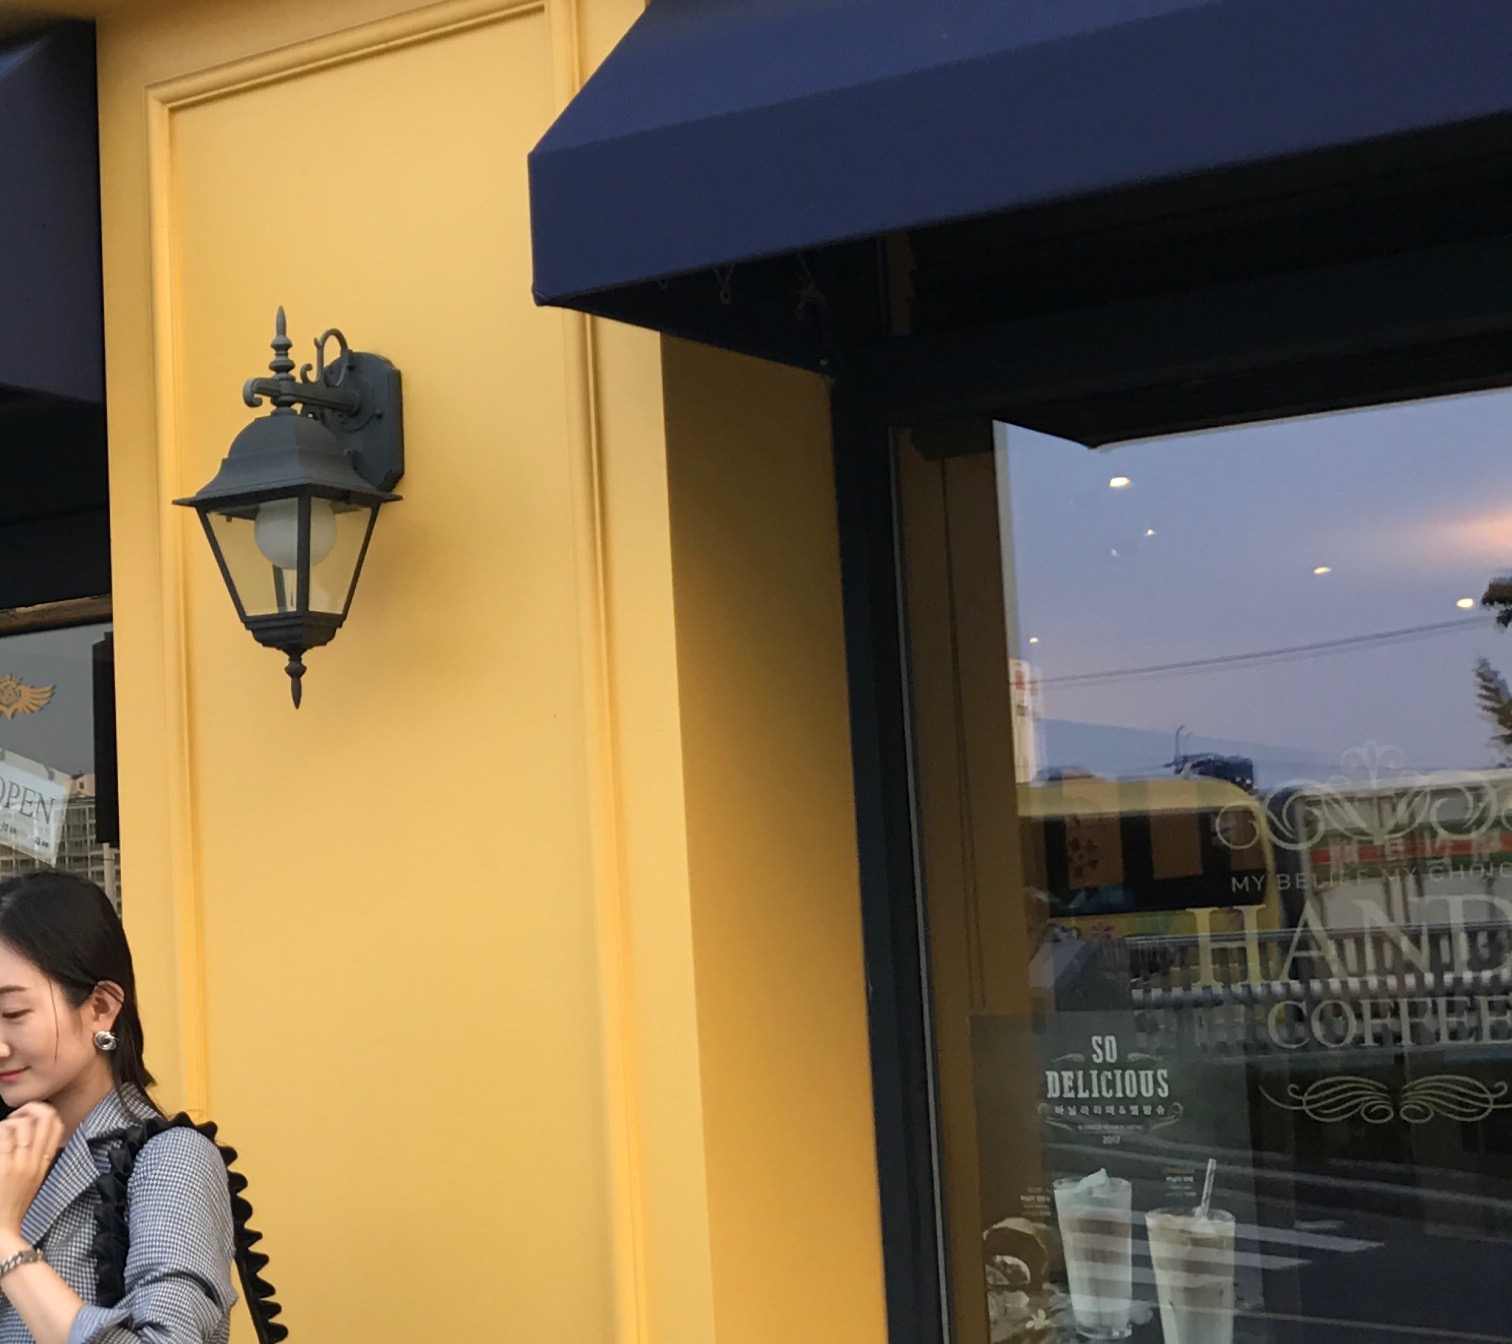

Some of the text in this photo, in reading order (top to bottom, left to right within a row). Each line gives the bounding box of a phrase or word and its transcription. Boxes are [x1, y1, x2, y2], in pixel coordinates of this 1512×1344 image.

[1231, 873, 1265, 893] MY
[1278, 869, 1370, 890] BELIEF
[1267, 995, 1512, 1050] COFFEE
[1091, 1035, 1118, 1063] SO
[1045, 1069, 1170, 1098] DELICIOUS
